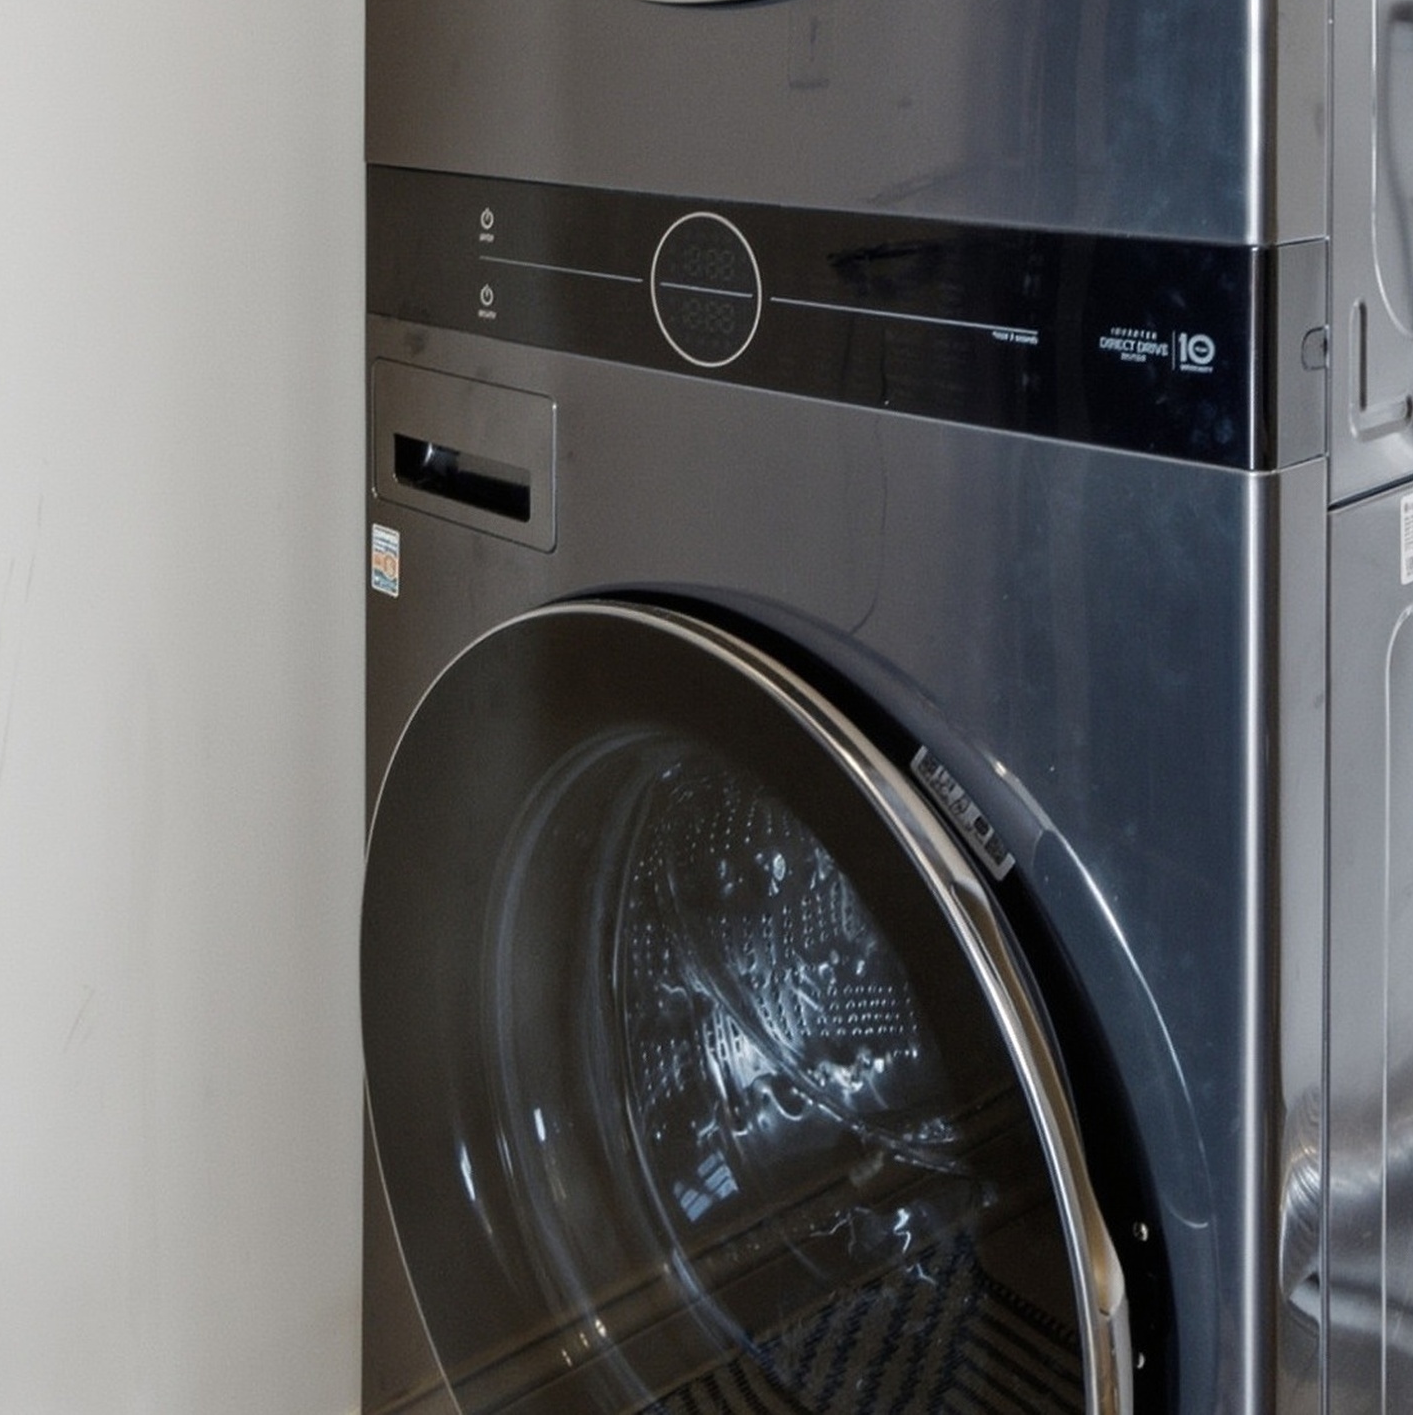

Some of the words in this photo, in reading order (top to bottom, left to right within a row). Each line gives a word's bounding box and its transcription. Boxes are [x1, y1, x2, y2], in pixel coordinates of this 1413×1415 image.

[1099, 336, 1136, 351] DIRECT
[1137, 340, 1169, 356] DRIVE
[1179, 332, 1215, 365] 10
